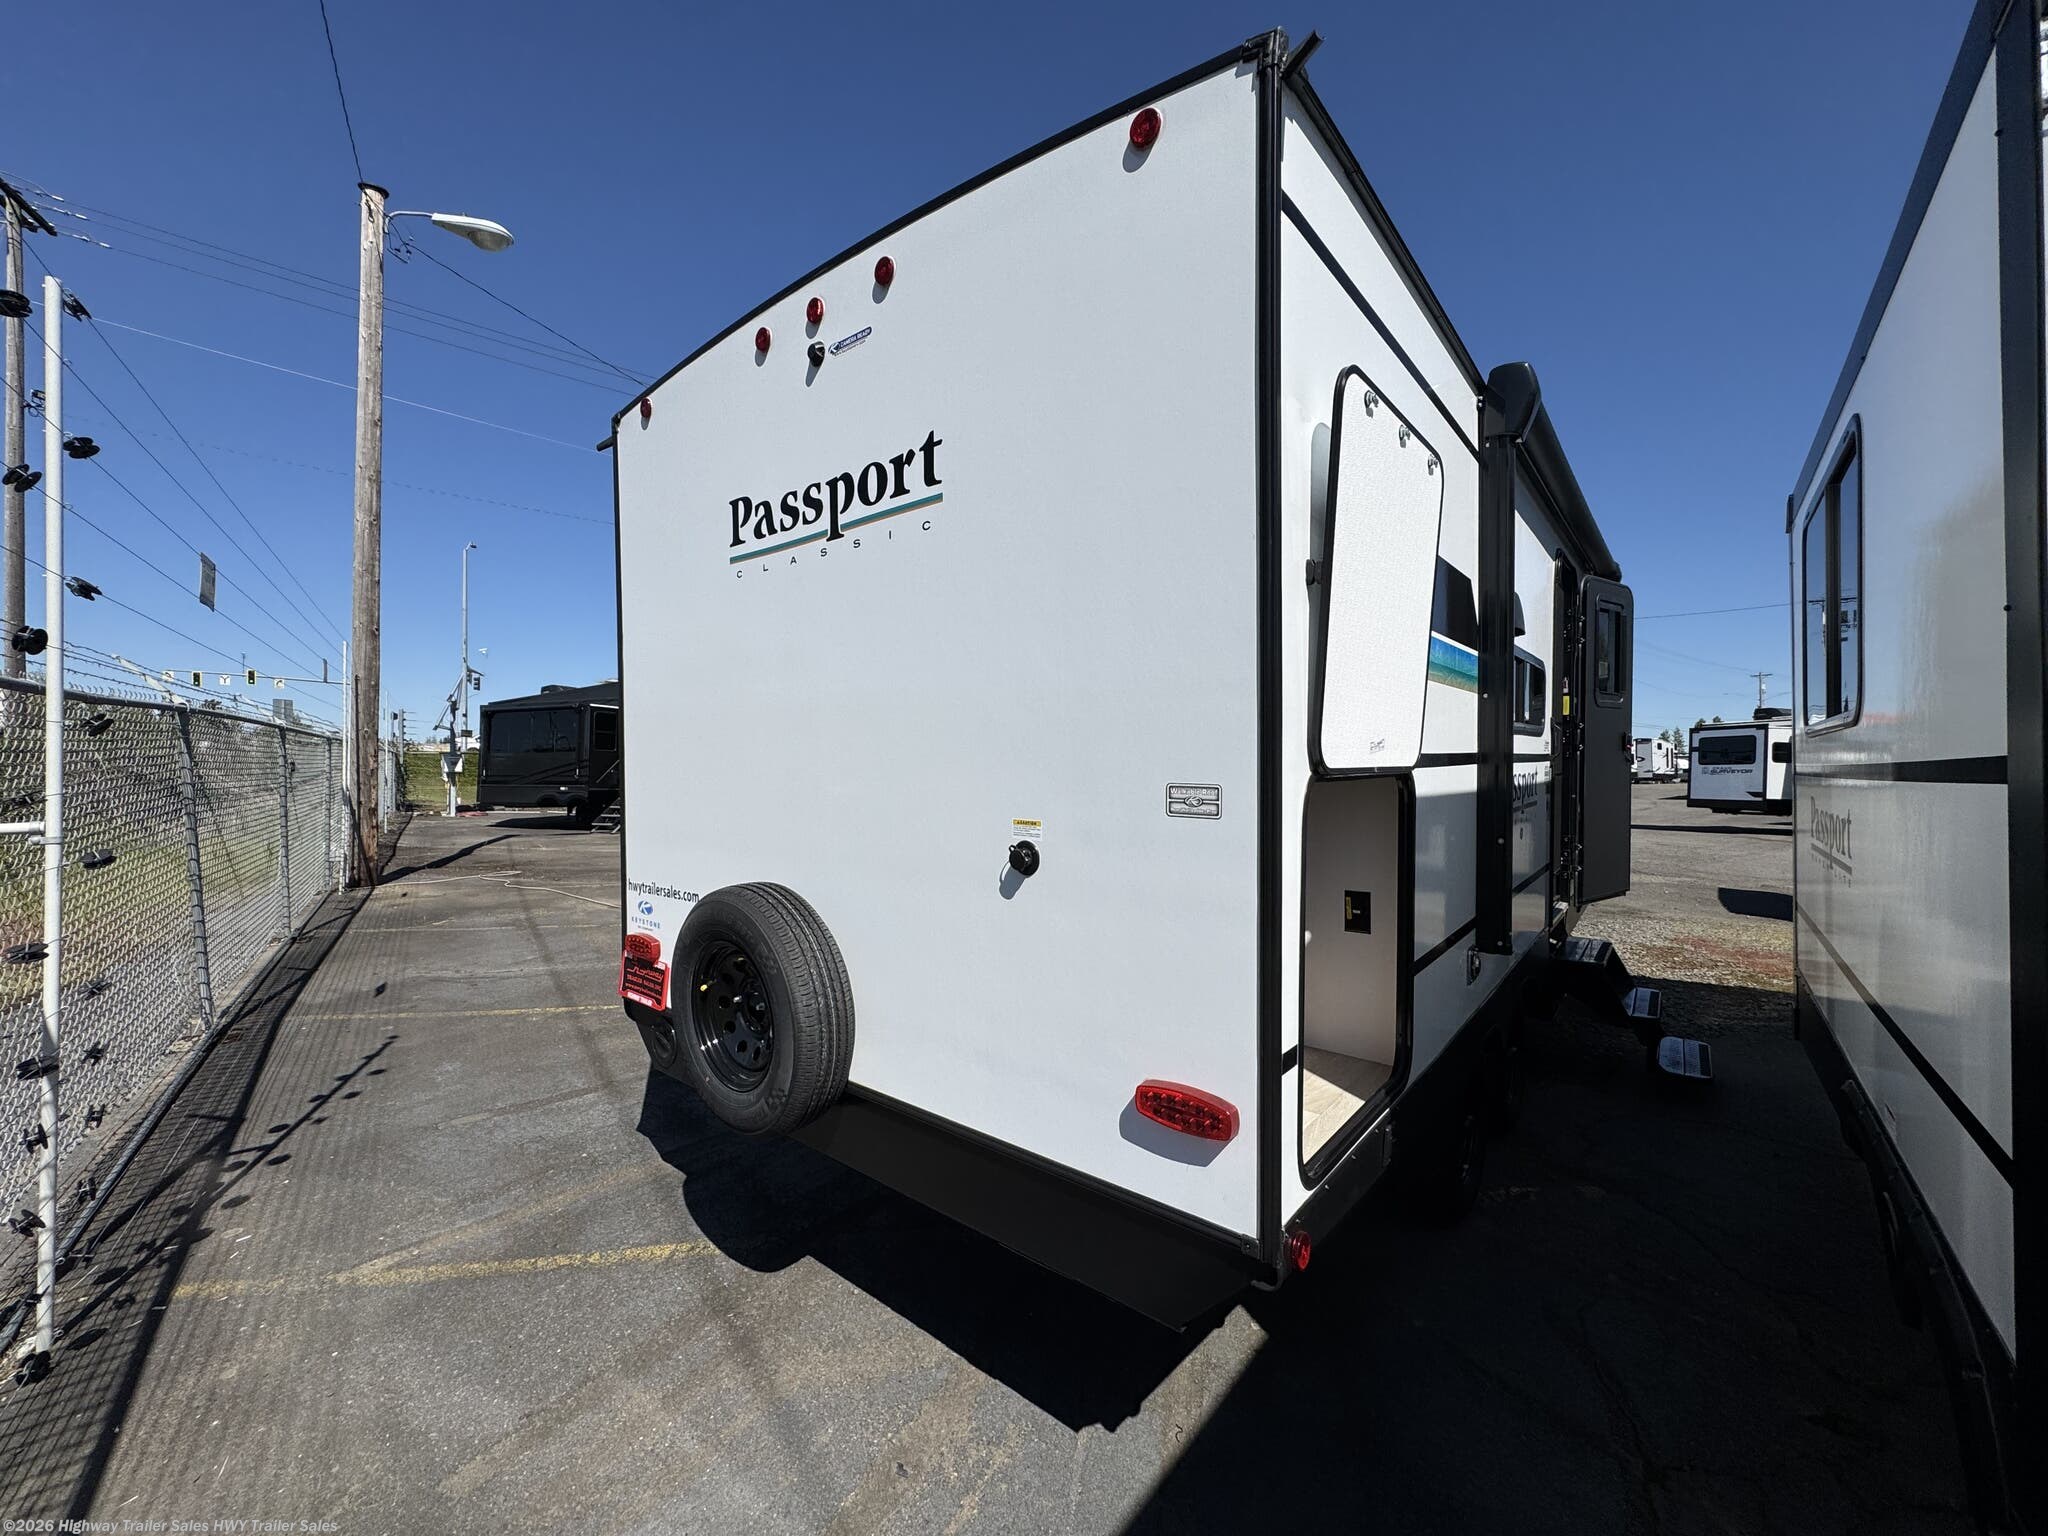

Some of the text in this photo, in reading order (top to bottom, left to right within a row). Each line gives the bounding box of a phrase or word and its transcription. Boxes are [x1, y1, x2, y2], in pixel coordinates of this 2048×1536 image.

[730, 430, 943, 548] Passport
[736, 520, 932, 579] CLASSIC
[1513, 766, 1537, 814] ssport
[1811, 796, 1852, 870] Passport
[628, 878, 700, 903] hwytrailersales.com
[631, 916, 661, 929] KEYSTONE
